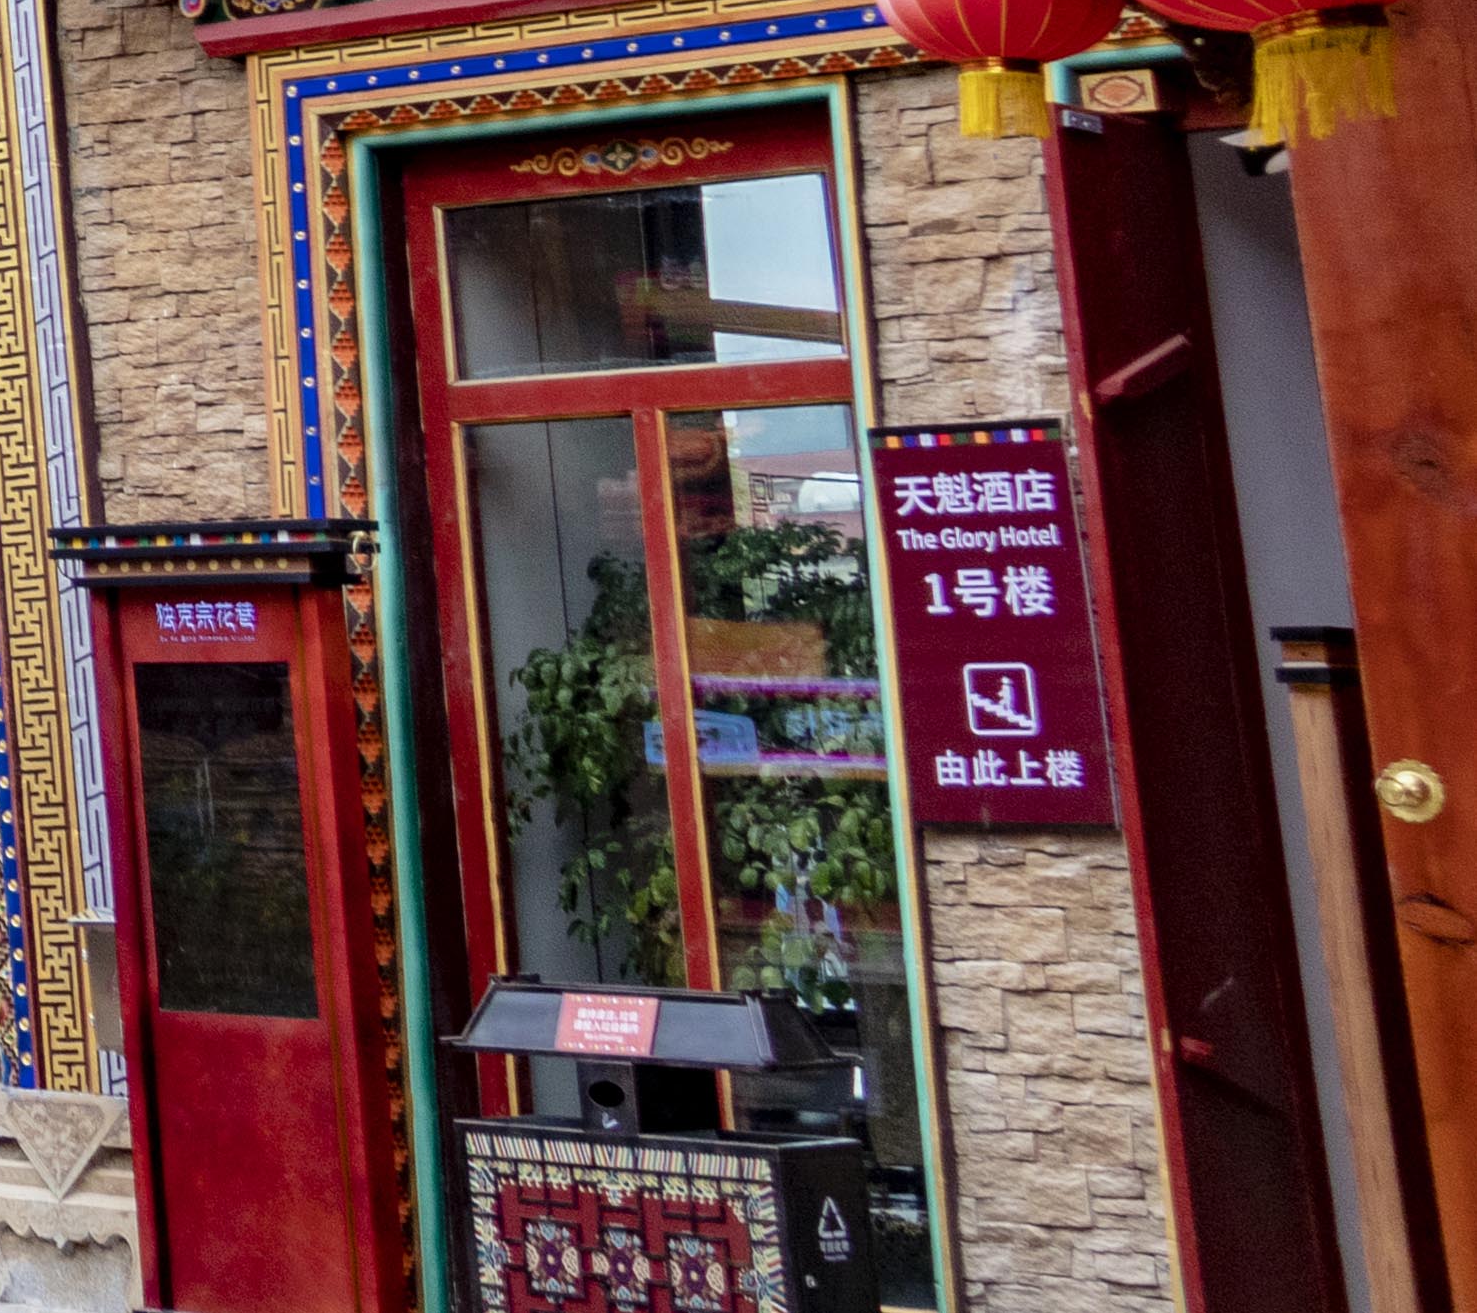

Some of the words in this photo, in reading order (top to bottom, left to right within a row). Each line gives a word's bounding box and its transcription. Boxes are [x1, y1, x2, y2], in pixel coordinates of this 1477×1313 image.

[893, 469, 1058, 517] 天魁酒店
[896, 527, 939, 551] The
[940, 525, 998, 553] Glory
[998, 523, 1062, 549] Hotel
[923, 563, 1056, 618] 1号楼
[934, 749, 1086, 789] 由此上楼
